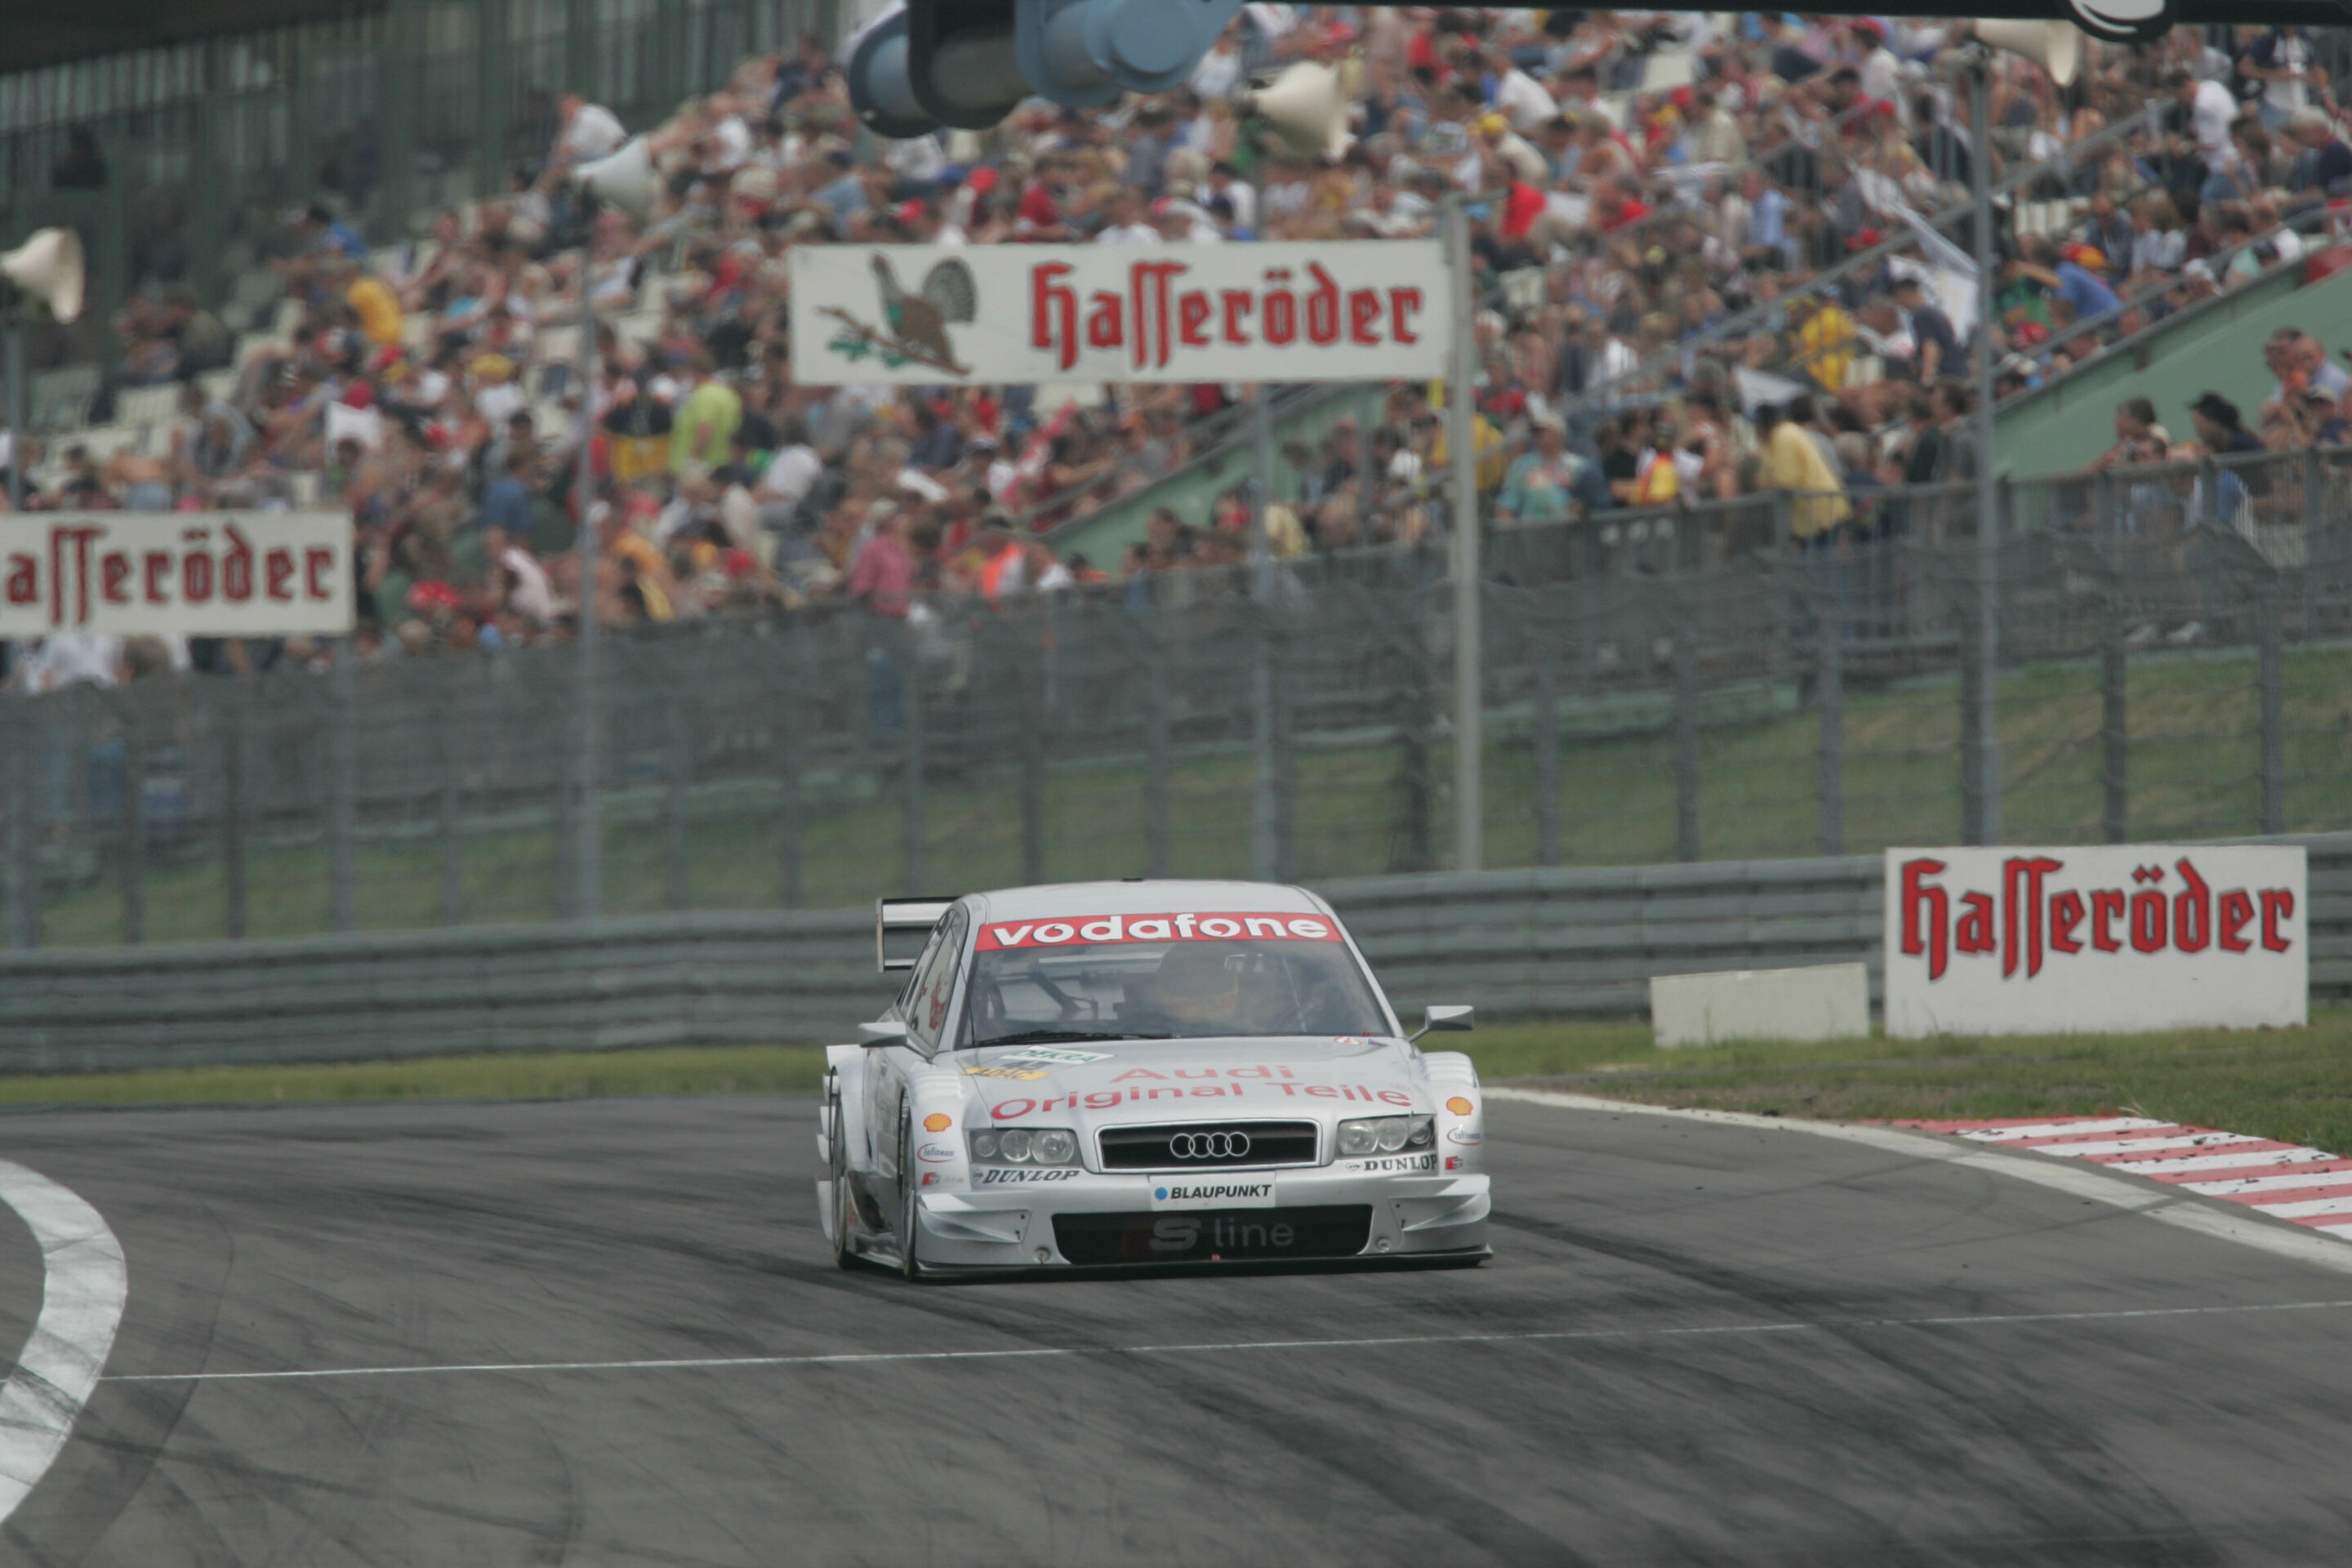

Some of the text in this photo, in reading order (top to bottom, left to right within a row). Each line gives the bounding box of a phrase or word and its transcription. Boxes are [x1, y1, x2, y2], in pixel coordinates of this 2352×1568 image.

[4, 522, 334, 626] asseröder
[992, 913, 1329, 947] vodafone
[1110, 1065, 1295, 1083] Audi
[990, 1082, 1412, 1120] Original Teile
[1363, 1153, 1437, 1171] DUNLOP
[982, 1169, 1080, 1184] DUNLOP
[1169, 1184, 1272, 1200] BLAUPUNKT
[1214, 1216, 1295, 1248] line
